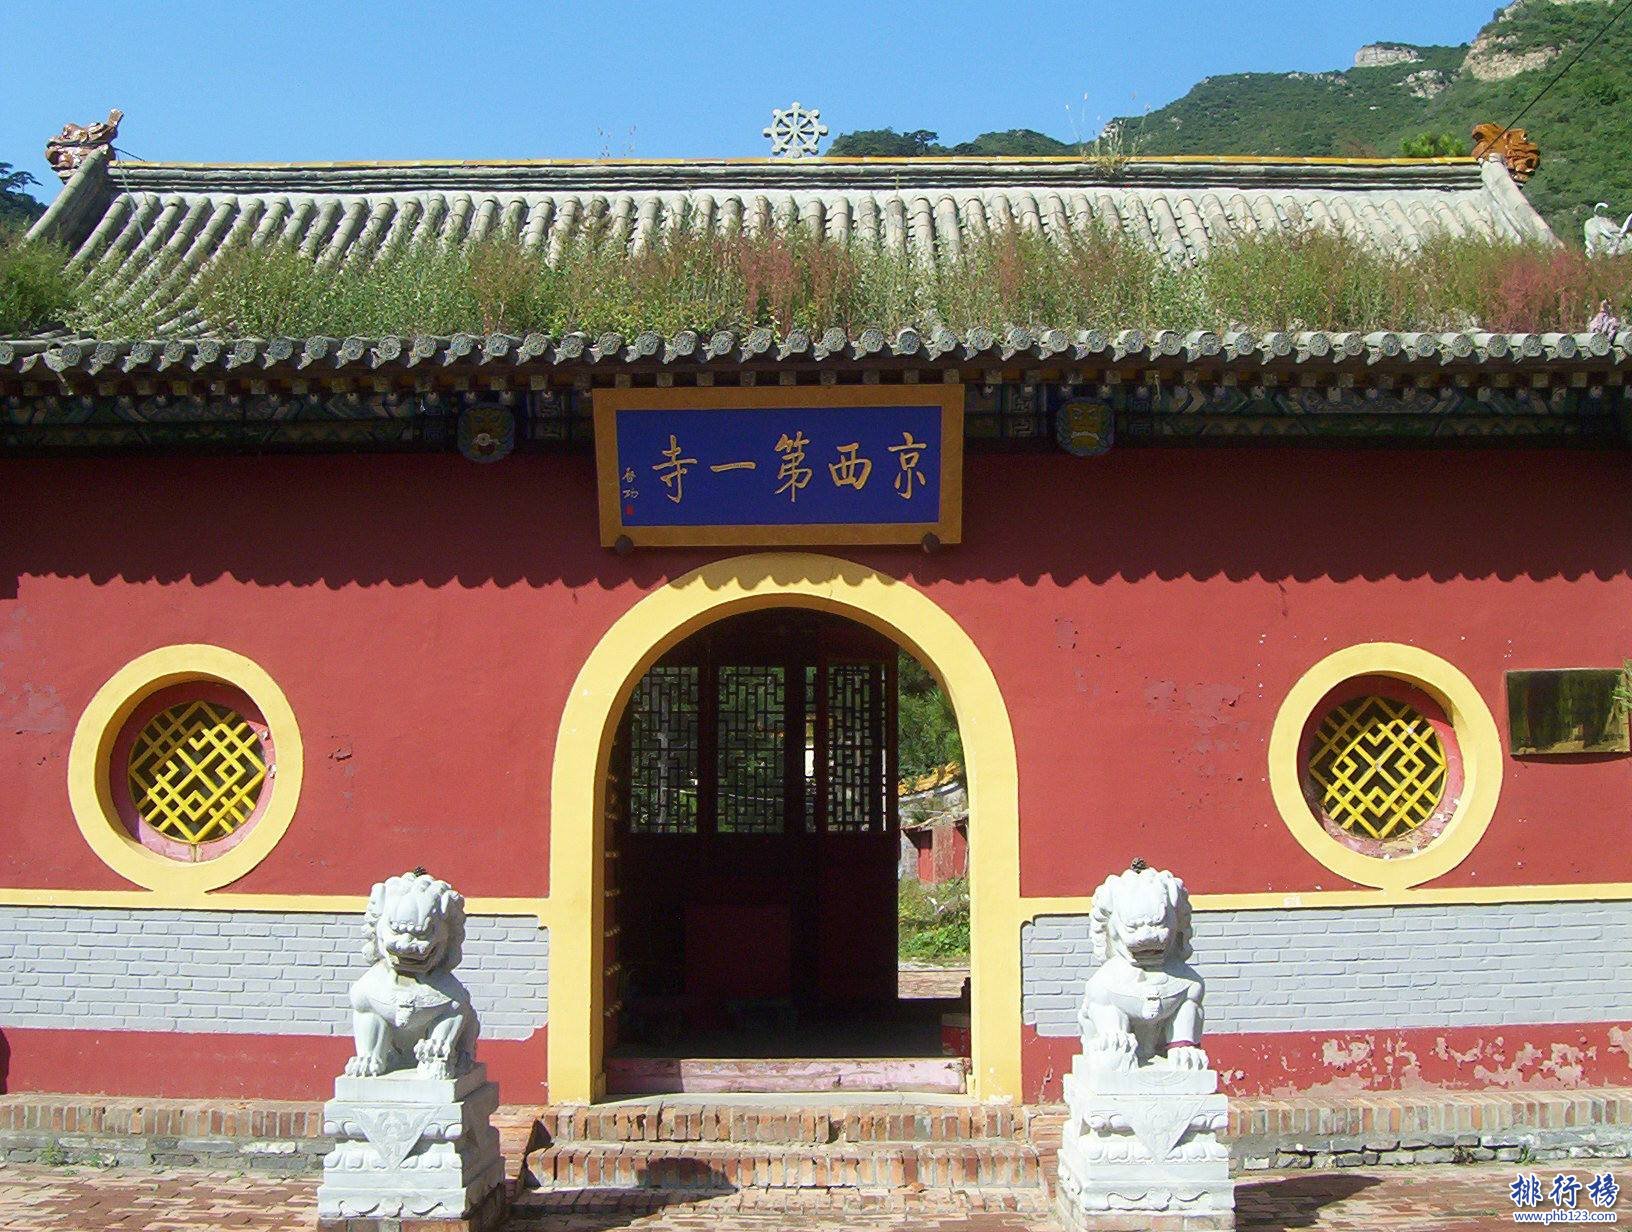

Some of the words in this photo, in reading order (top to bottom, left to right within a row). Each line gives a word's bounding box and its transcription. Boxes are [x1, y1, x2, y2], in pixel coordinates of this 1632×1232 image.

[651, 431, 928, 503] 京西第一寺
